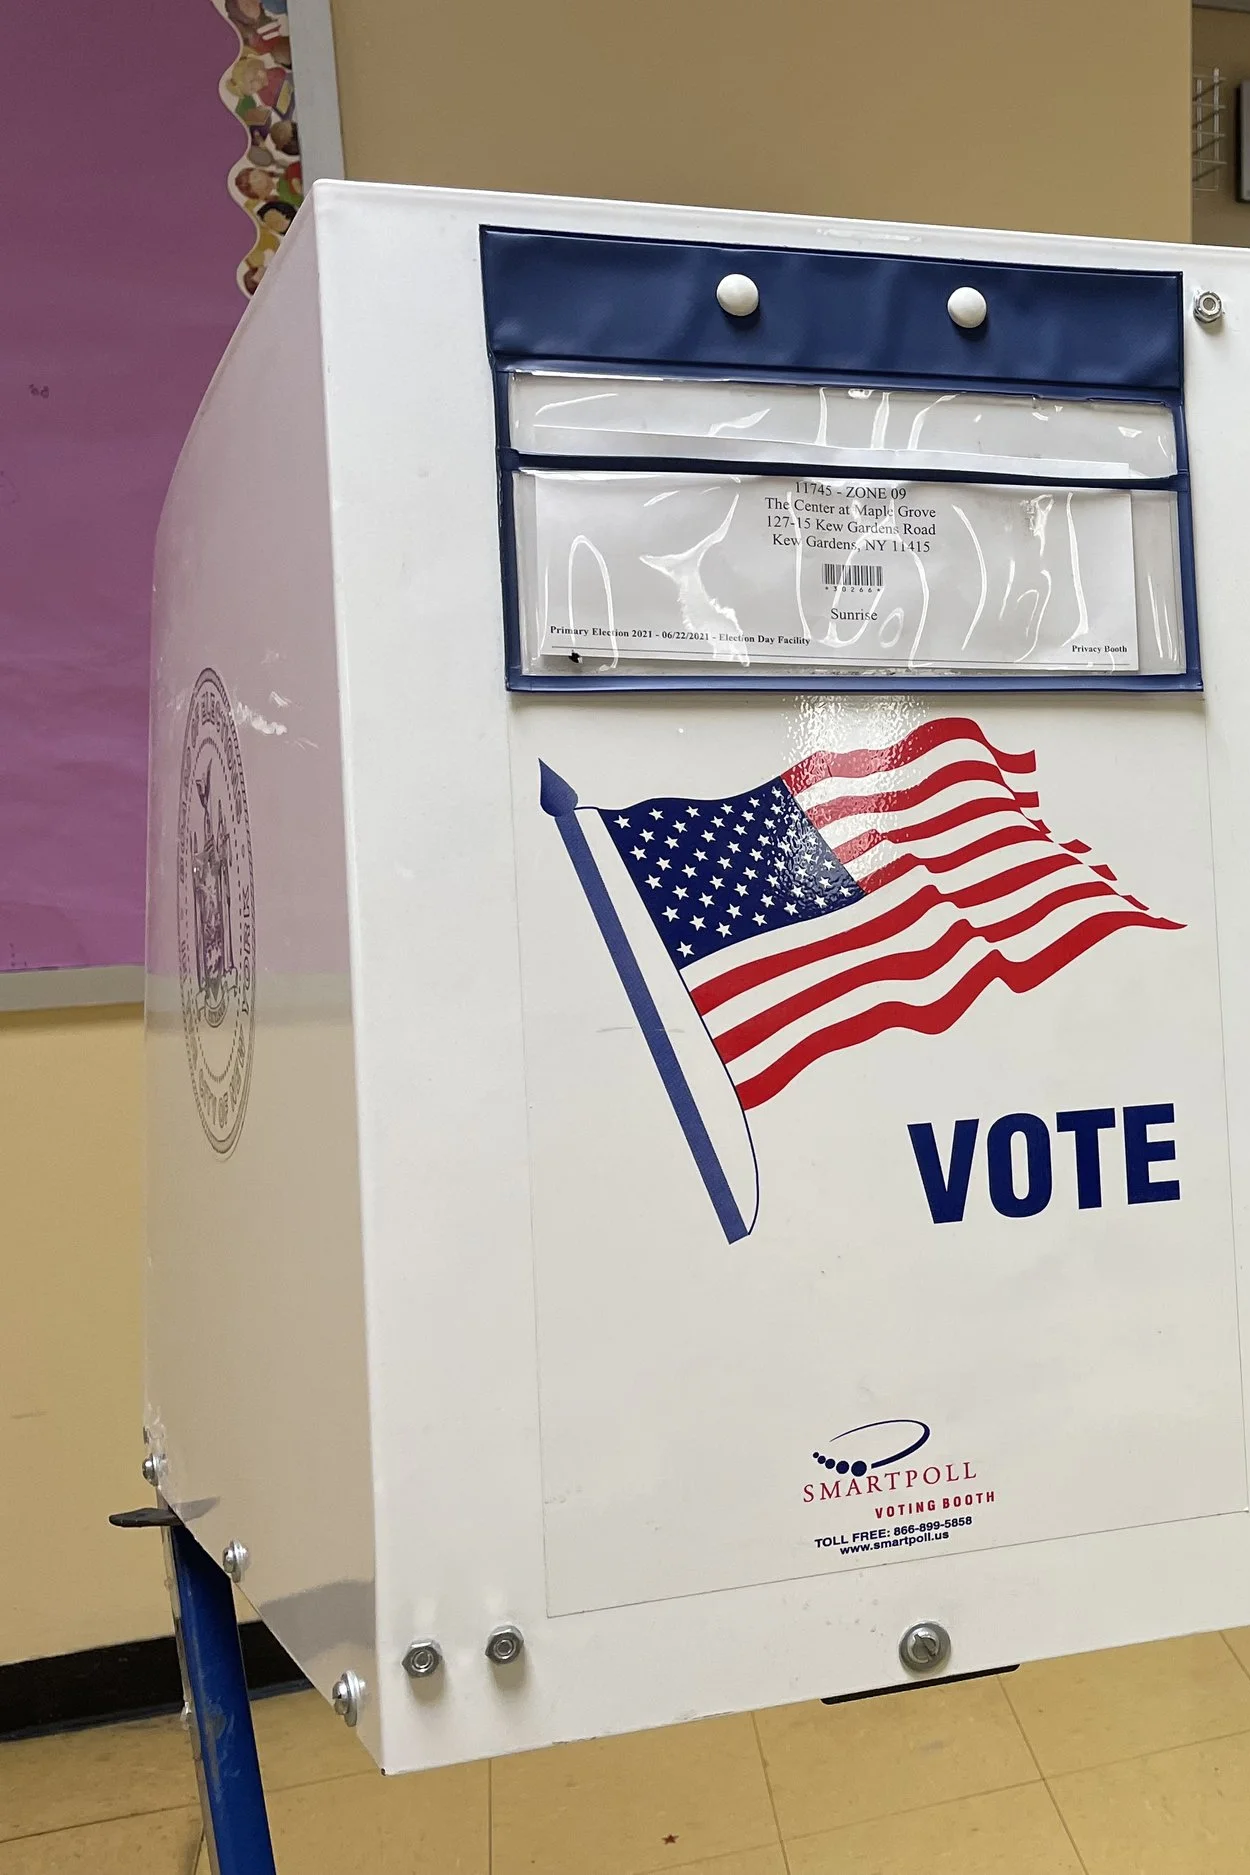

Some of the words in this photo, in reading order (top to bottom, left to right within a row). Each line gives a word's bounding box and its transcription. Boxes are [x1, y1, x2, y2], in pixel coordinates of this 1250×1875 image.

[795, 481, 832, 496] 11745
[845, 486, 887, 499] ZONE
[891, 487, 907, 500] 09
[765, 497, 790, 510] The
[794, 499, 834, 514] Center
[839, 504, 850, 515] at
[854, 505, 893, 520] Maple
[898, 505, 936, 518] Grove
[767, 515, 811, 530] 127-15
[816, 519, 843, 532] Kew
[847, 521, 899, 535] Gardens
[903, 523, 936, 535] Road
[773, 533, 801, 546] Kew
[806, 535, 861, 552] Gardens,
[865, 540, 887, 551] NY
[893, 540, 930, 552] 11415
[830, 608, 878, 621] Sunrise
[550, 625, 589, 637] Primary
[592, 627, 629, 638] Election
[631, 629, 652, 638] 2021
[662, 630, 709, 641] 06/22/2021
[719, 633, 755, 643] Election
[757, 635, 776, 645] Day
[778, 635, 811, 646] Facility
[1072, 645, 1101, 653] Privacy
[1104, 645, 1128, 653] Booth
[906, 1103, 1180, 1224] VOTE
[803, 1462, 977, 1503] SMARTPOLL
[875, 1499, 936, 1519] VOTING
[942, 1491, 995, 1510] BOOTH
[814, 1535, 848, 1548] TOLL
[852, 1528, 891, 1543] FREE:
[893, 1516, 973, 1537] 866-899-5858
[839, 1531, 950, 1555] www.smartpoll.us
